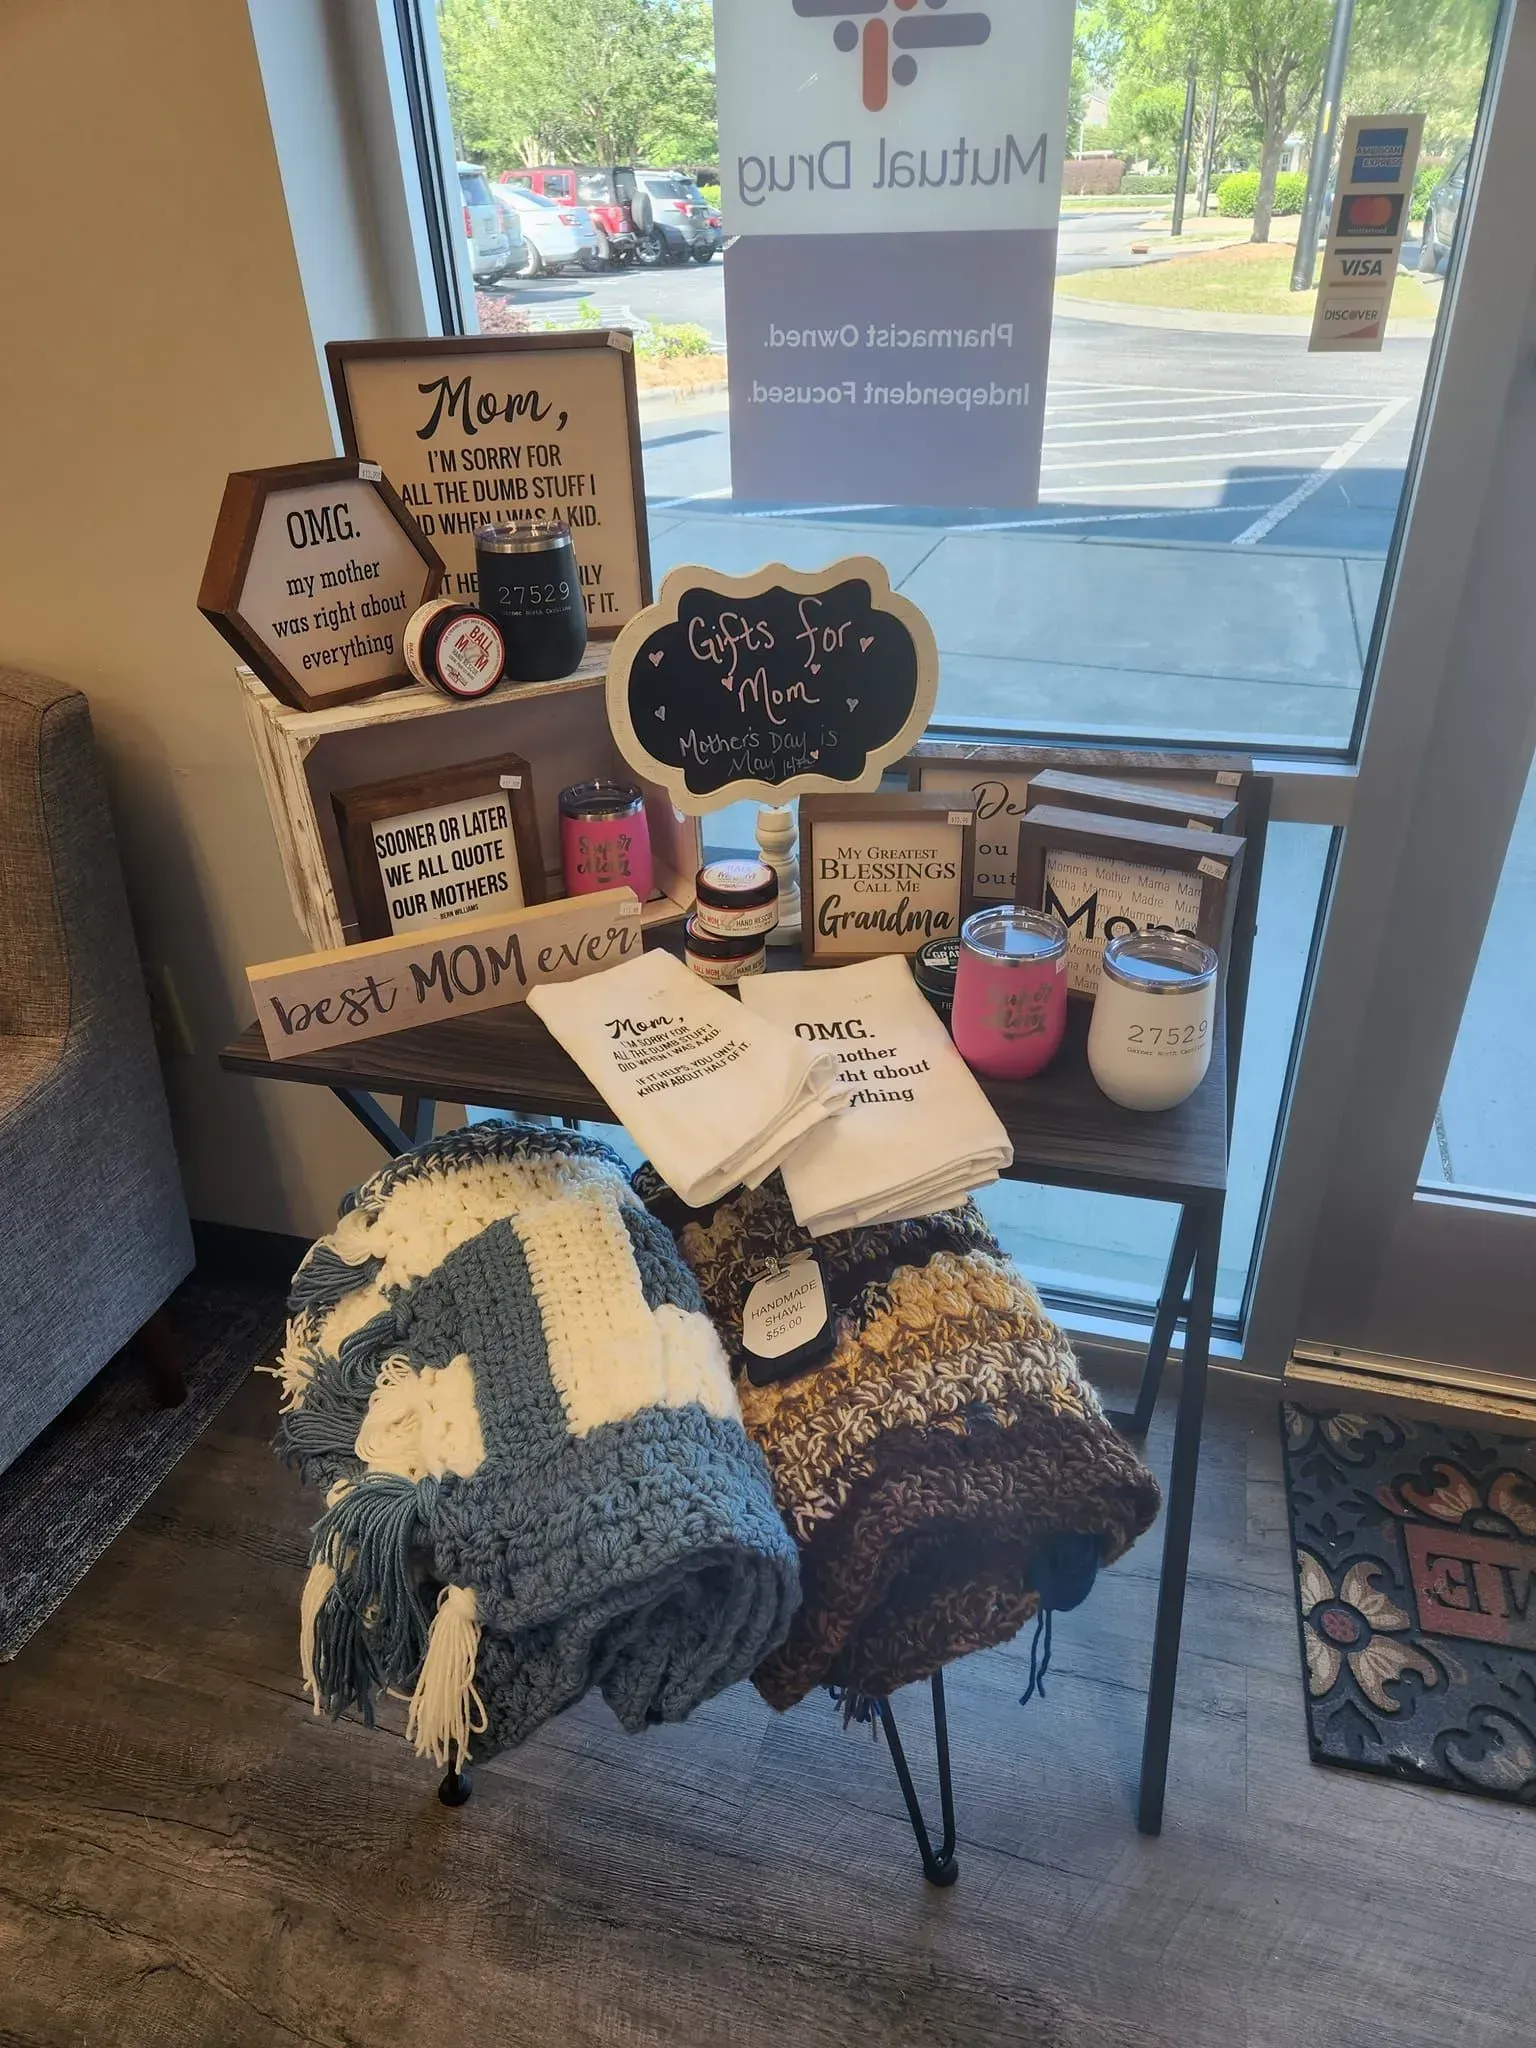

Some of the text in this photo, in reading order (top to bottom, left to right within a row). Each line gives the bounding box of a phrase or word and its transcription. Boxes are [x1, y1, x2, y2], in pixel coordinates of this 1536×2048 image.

[1340, 259, 1383, 276] VISA
[1324, 310, 1378, 321] DISCOVER
[416, 375, 568, 440] Mom,
[428, 444, 562, 473] I'M SORRY FOR
[402, 474, 596, 506] ALL THE DUMB STUFF I
[286, 503, 361, 549] OMG.
[416, 515, 436, 536] ID
[567, 504, 601, 528] KID.
[286, 559, 381, 598] my mother
[579, 564, 602, 586] LY
[498, 581, 570, 605] 27529
[600, 592, 619, 613] IT.
[271, 590, 407, 639] was right about
[302, 634, 394, 670] everything
[469, 625, 493, 656] BALL
[689, 597, 851, 676] Gifts for
[738, 667, 820, 724] Mom
[679, 725, 839, 765] Mother's Day is
[728, 751, 775, 780] May
[971, 781, 1027, 820] De
[375, 805, 508, 859] SOONER OR LATER
[385, 840, 505, 888] WE ALL QUOTE
[819, 858, 956, 880] BLESSINGS
[1047, 859, 1088, 877] Momma
[1095, 867, 1131, 884] Mother
[1138, 875, 1170, 892] Mama
[392, 871, 509, 920] OUR MOTHERS
[454, 903, 479, 916] WILLIAMS
[1131, 891, 1165, 907] Madre
[818, 894, 955, 938] Grandma
[1119, 906, 1162, 925] Mummy
[270, 926, 638, 1036] best MOM ever
[604, 1015, 684, 1039] Mom,
[639, 1032, 670, 1048] SORRY
[671, 1025, 690, 1037] FOR
[794, 1019, 876, 1041] OMG.
[1128, 1019, 1207, 1045] 27529
[613, 1050, 631, 1061] ALL
[630, 1047, 651, 1059] THE
[652, 1040, 679, 1054] DUMB
[679, 1028, 708, 1045] STUFF
[617, 1062, 638, 1073] DID
[636, 1053, 668, 1067] WHEN
[671, 1043, 696, 1055] WAS
[695, 1040, 704, 1049] A
[636, 1077, 648, 1086] IF
[646, 1074, 659, 1083] IT
[690, 1055, 714, 1068] YOU
[712, 1040, 736, 1059] ONLY
[636, 1079, 670, 1098] KNOW
[670, 1069, 705, 1087] ABOUT
[703, 1059, 729, 1075] HALF
[727, 1050, 741, 1062] OF
[873, 1059, 931, 1080] about
[849, 1088, 915, 1108] ything
[751, 1279, 817, 1320] HANDMADE
[765, 1301, 806, 1327] SHAWL
[766, 1316, 802, 1341] $55.00
